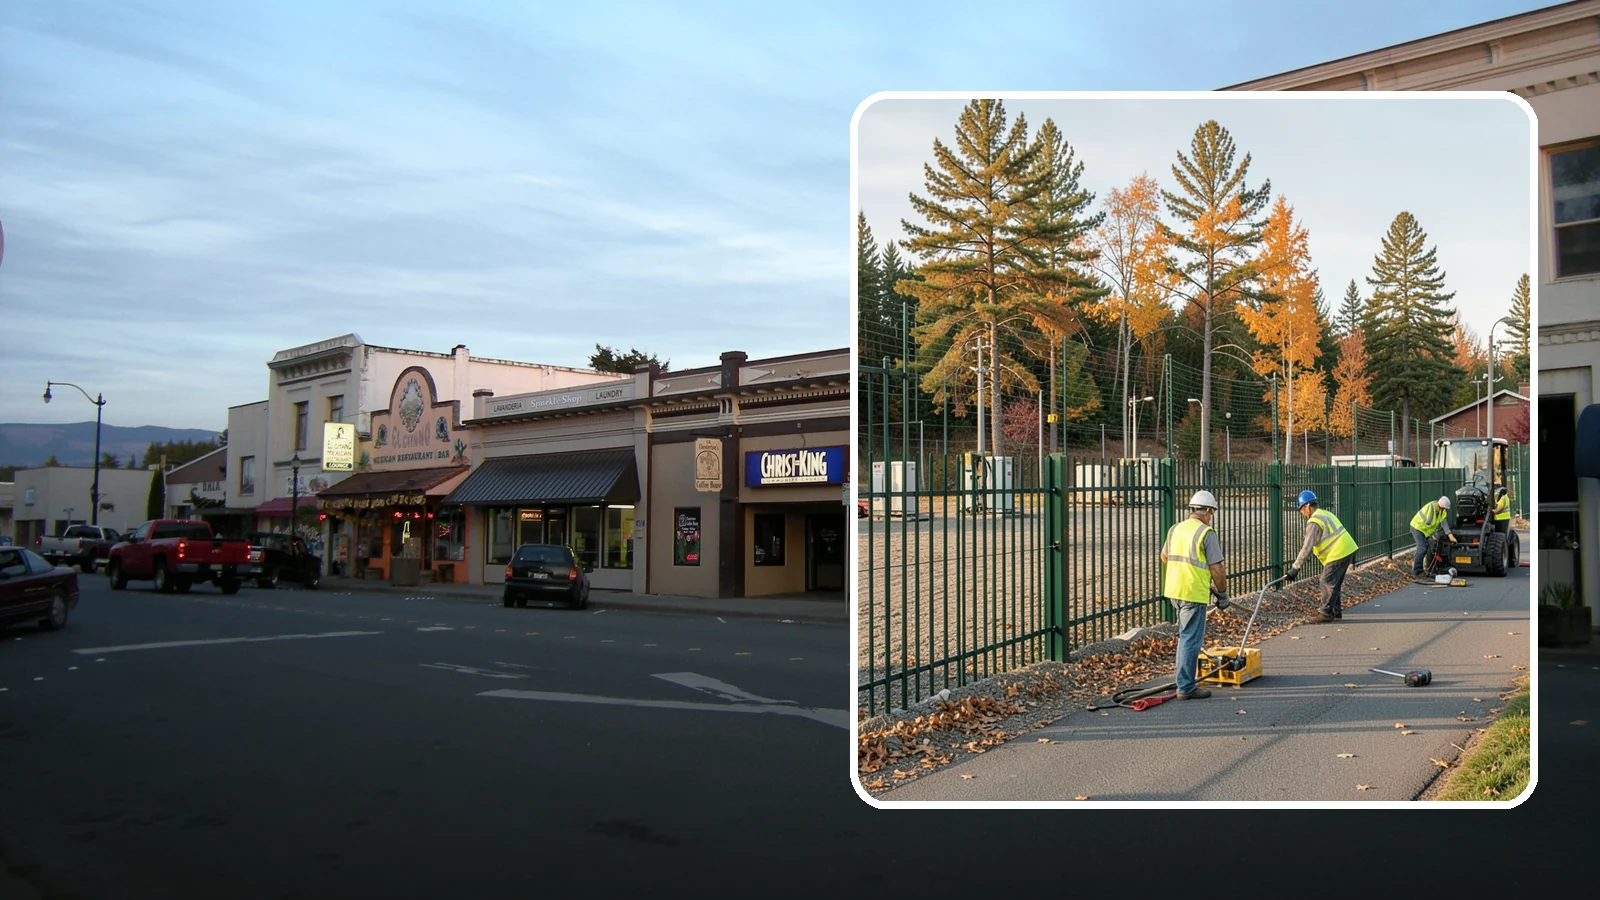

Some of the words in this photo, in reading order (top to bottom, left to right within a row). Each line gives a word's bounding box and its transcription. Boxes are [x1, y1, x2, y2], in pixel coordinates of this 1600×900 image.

[562, 394, 583, 405] Shop
[595, 389, 623, 400] LAUNDRY
[493, 402, 522, 413] LAVANDERIA
[373, 455, 397, 464] MEXICAN
[397, 452, 433, 462] RESTAURANT
[438, 450, 450, 459] BAR
[761, 452, 797, 478] CHRIST
[799, 450, 827, 476] KING
